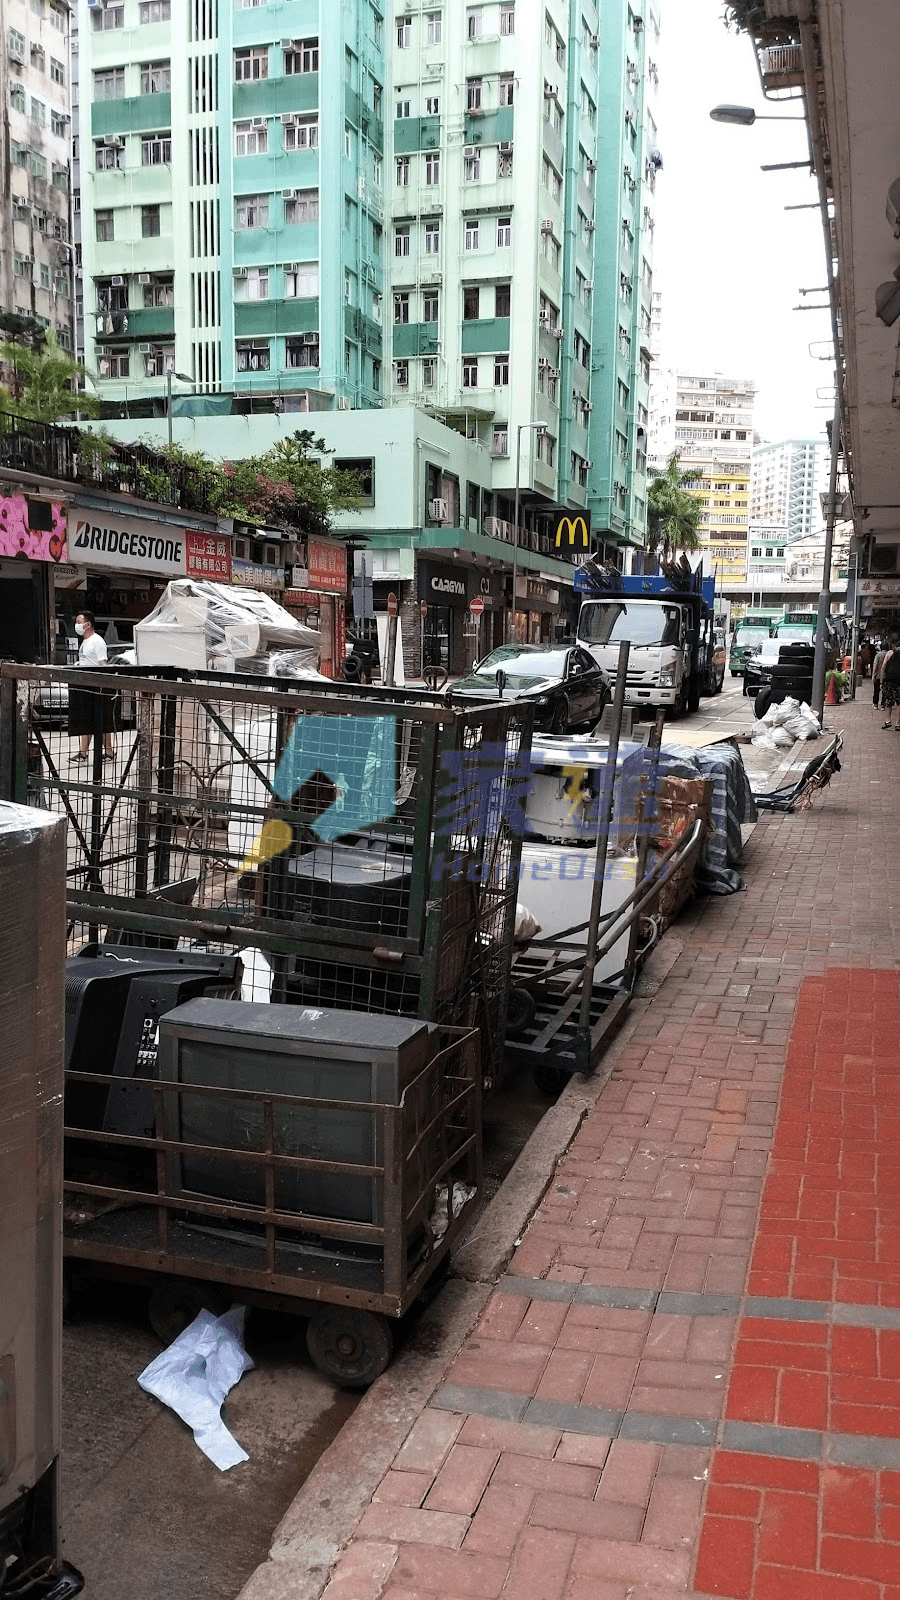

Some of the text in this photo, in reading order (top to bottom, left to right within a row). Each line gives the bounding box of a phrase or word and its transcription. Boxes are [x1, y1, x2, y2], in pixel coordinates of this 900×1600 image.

[74, 521, 182, 562] BRIDGESTONE
[205, 539, 227, 558] 金威
[431, 576, 465, 595] CARGYM
